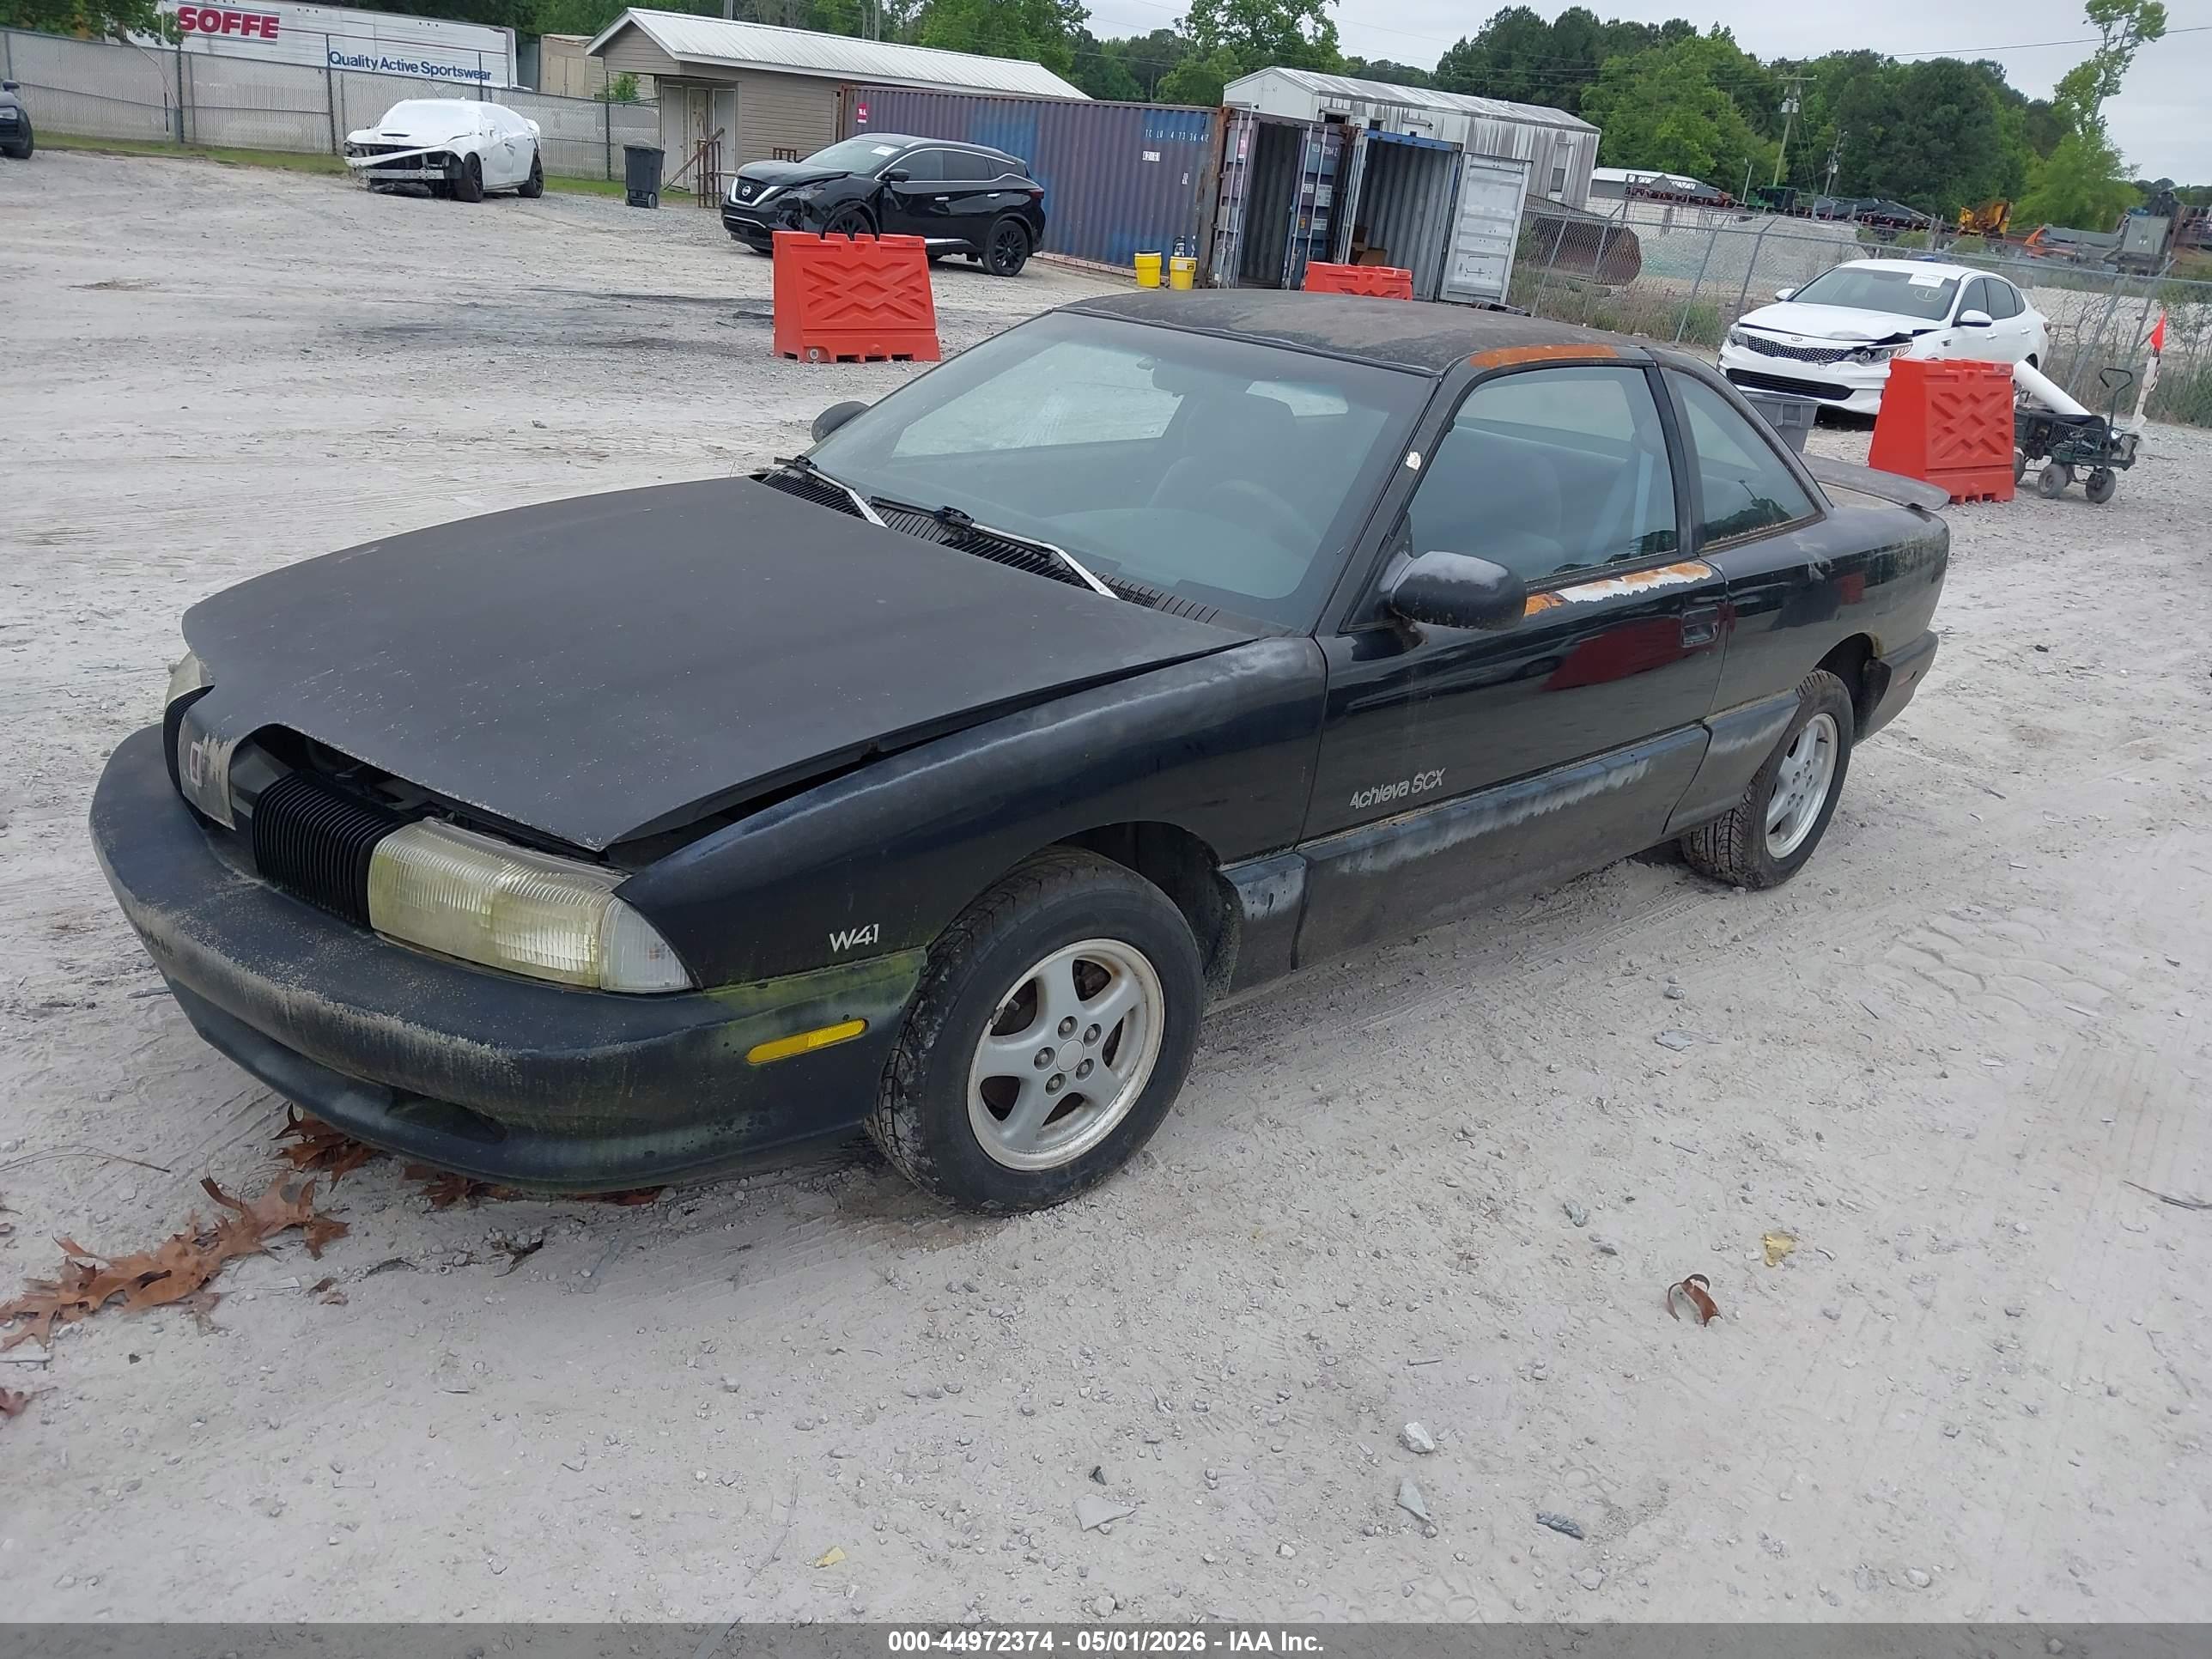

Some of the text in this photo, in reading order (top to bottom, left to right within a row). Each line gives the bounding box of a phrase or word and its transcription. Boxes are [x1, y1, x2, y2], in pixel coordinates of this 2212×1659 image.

[178, 6, 280, 39] SOFFE
[330, 51, 491, 81] Quality Active Sportswear
[1349, 768, 1446, 809] Achieva SCX
[829, 923, 879, 954] W41
